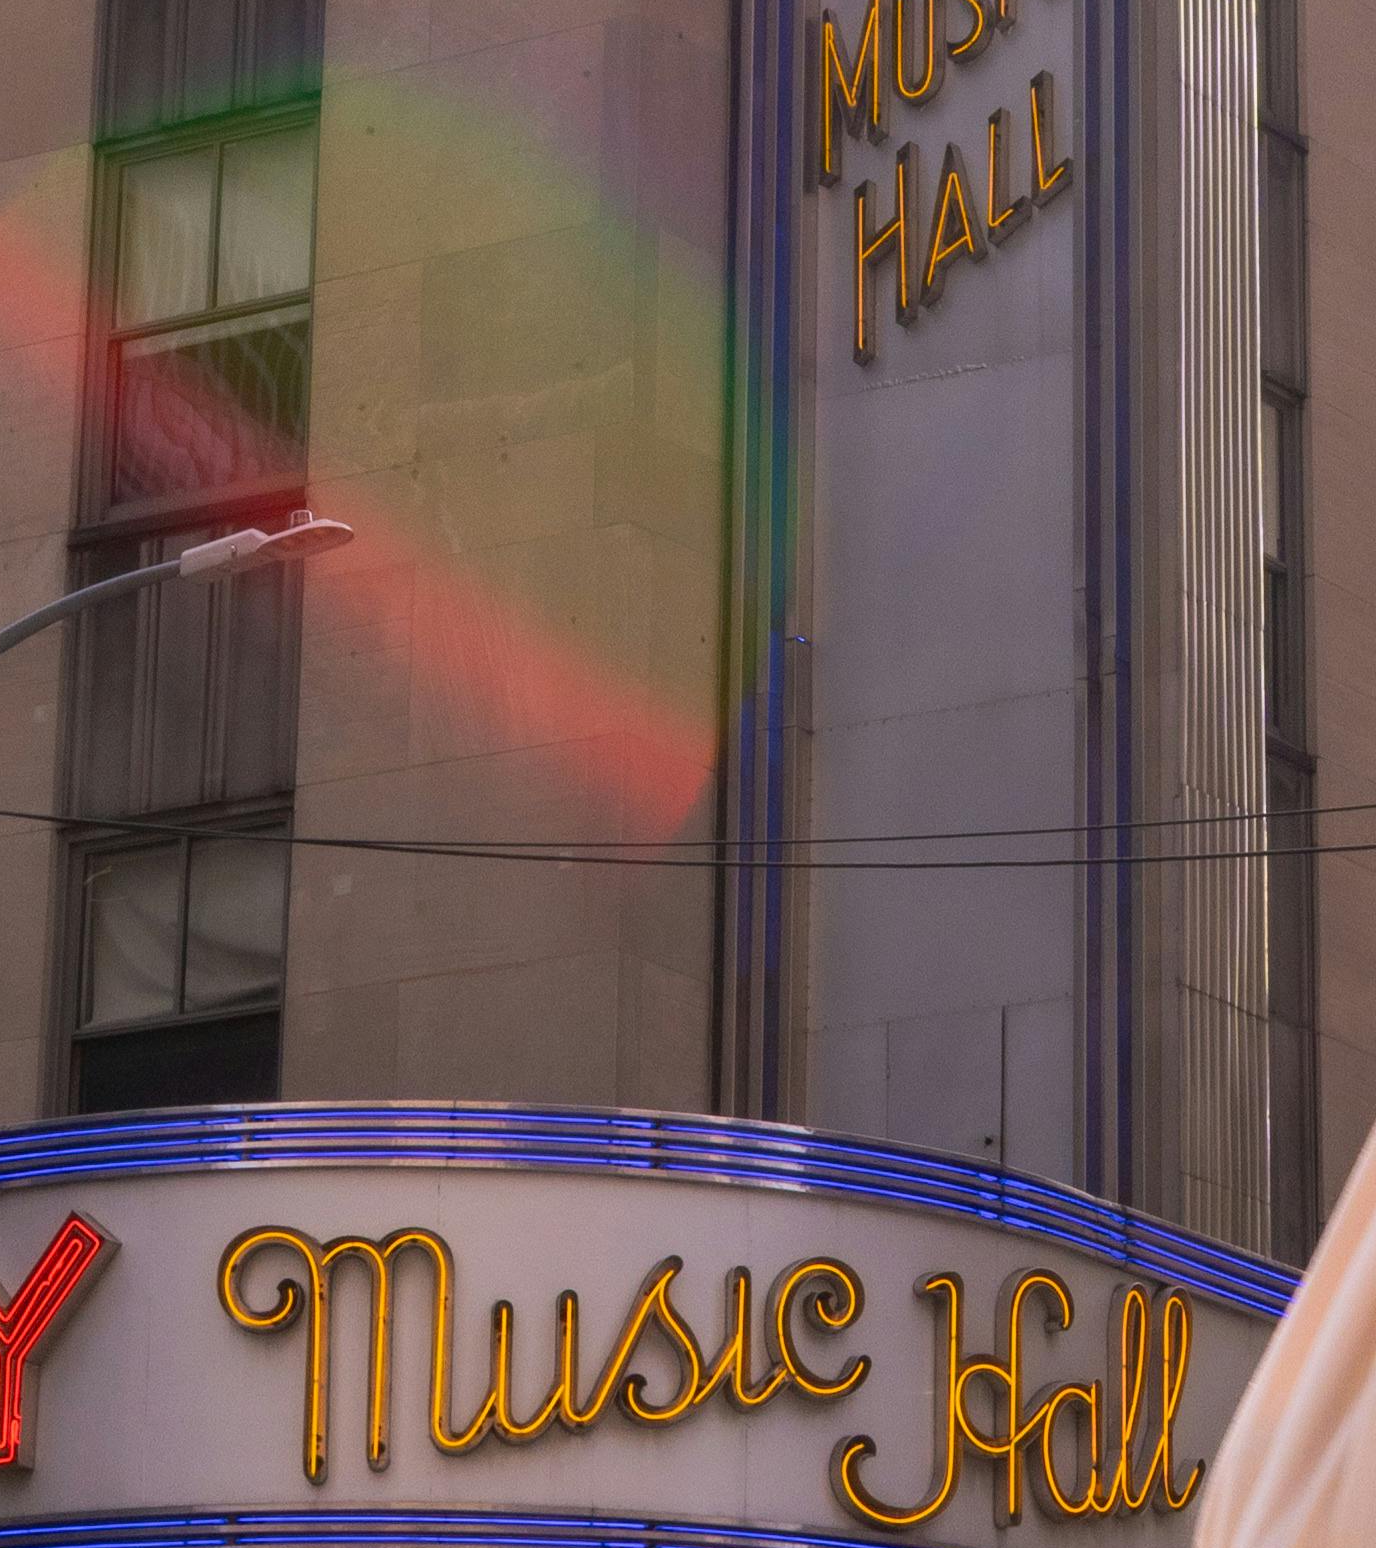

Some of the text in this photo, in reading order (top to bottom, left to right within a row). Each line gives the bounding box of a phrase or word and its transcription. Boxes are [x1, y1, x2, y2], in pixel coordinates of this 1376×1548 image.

[850, 70, 1073, 365] HALL
[216, 1224, 873, 1486] Music
[829, 1266, 1207, 1531] Hall
